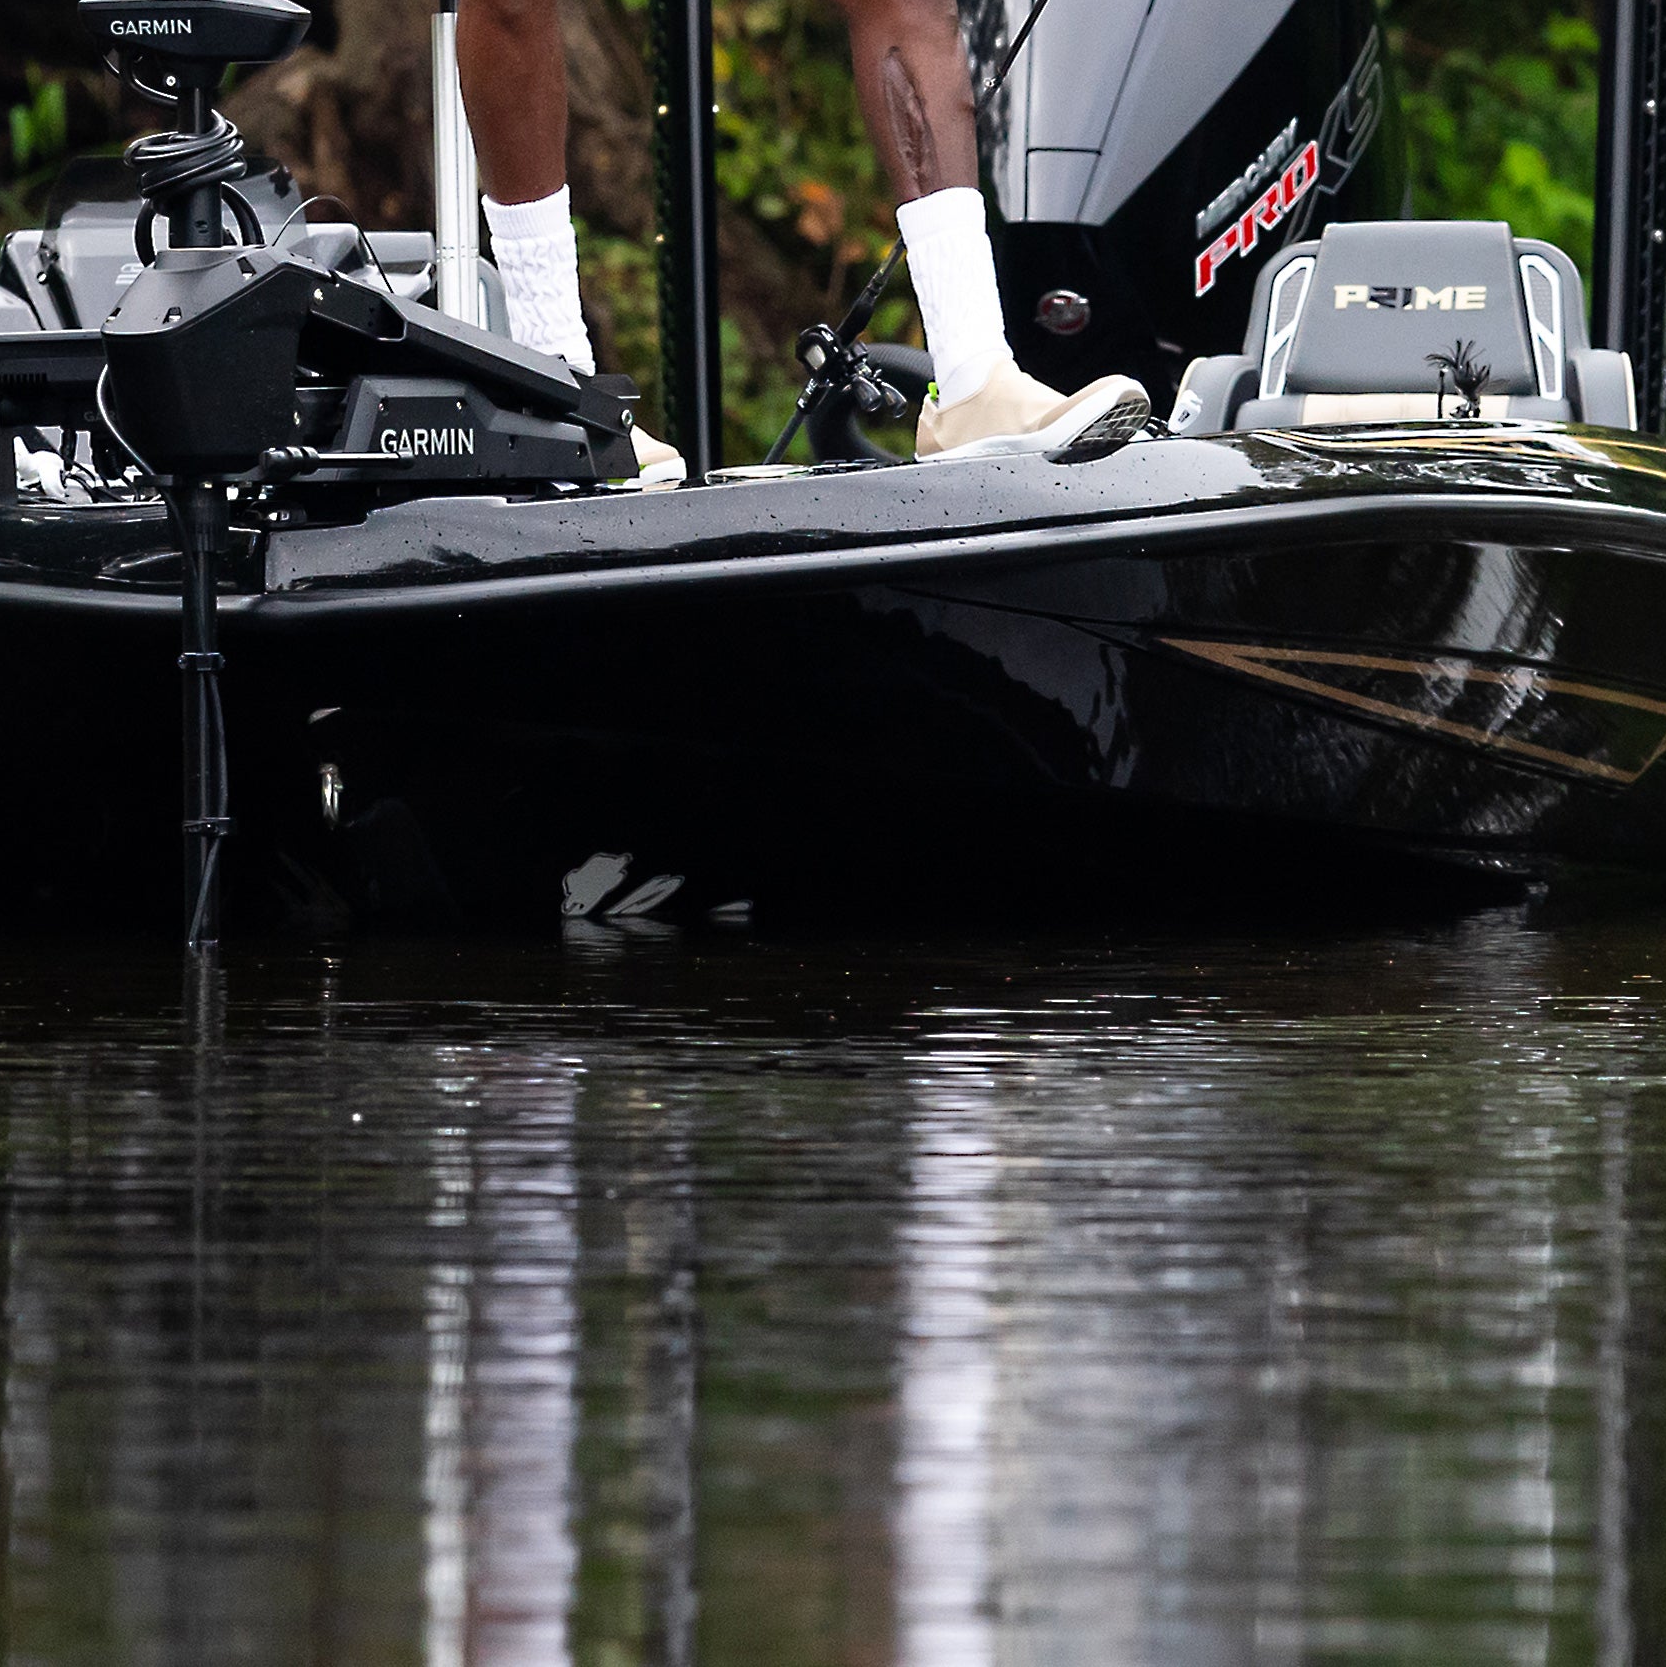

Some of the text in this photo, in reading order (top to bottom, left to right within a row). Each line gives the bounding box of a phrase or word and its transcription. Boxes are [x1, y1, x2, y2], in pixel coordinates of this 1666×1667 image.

[110, 19, 193, 35] GARMIN
[1195, 139, 1321, 299] PRO
[380, 428, 474, 455] GARMIN
